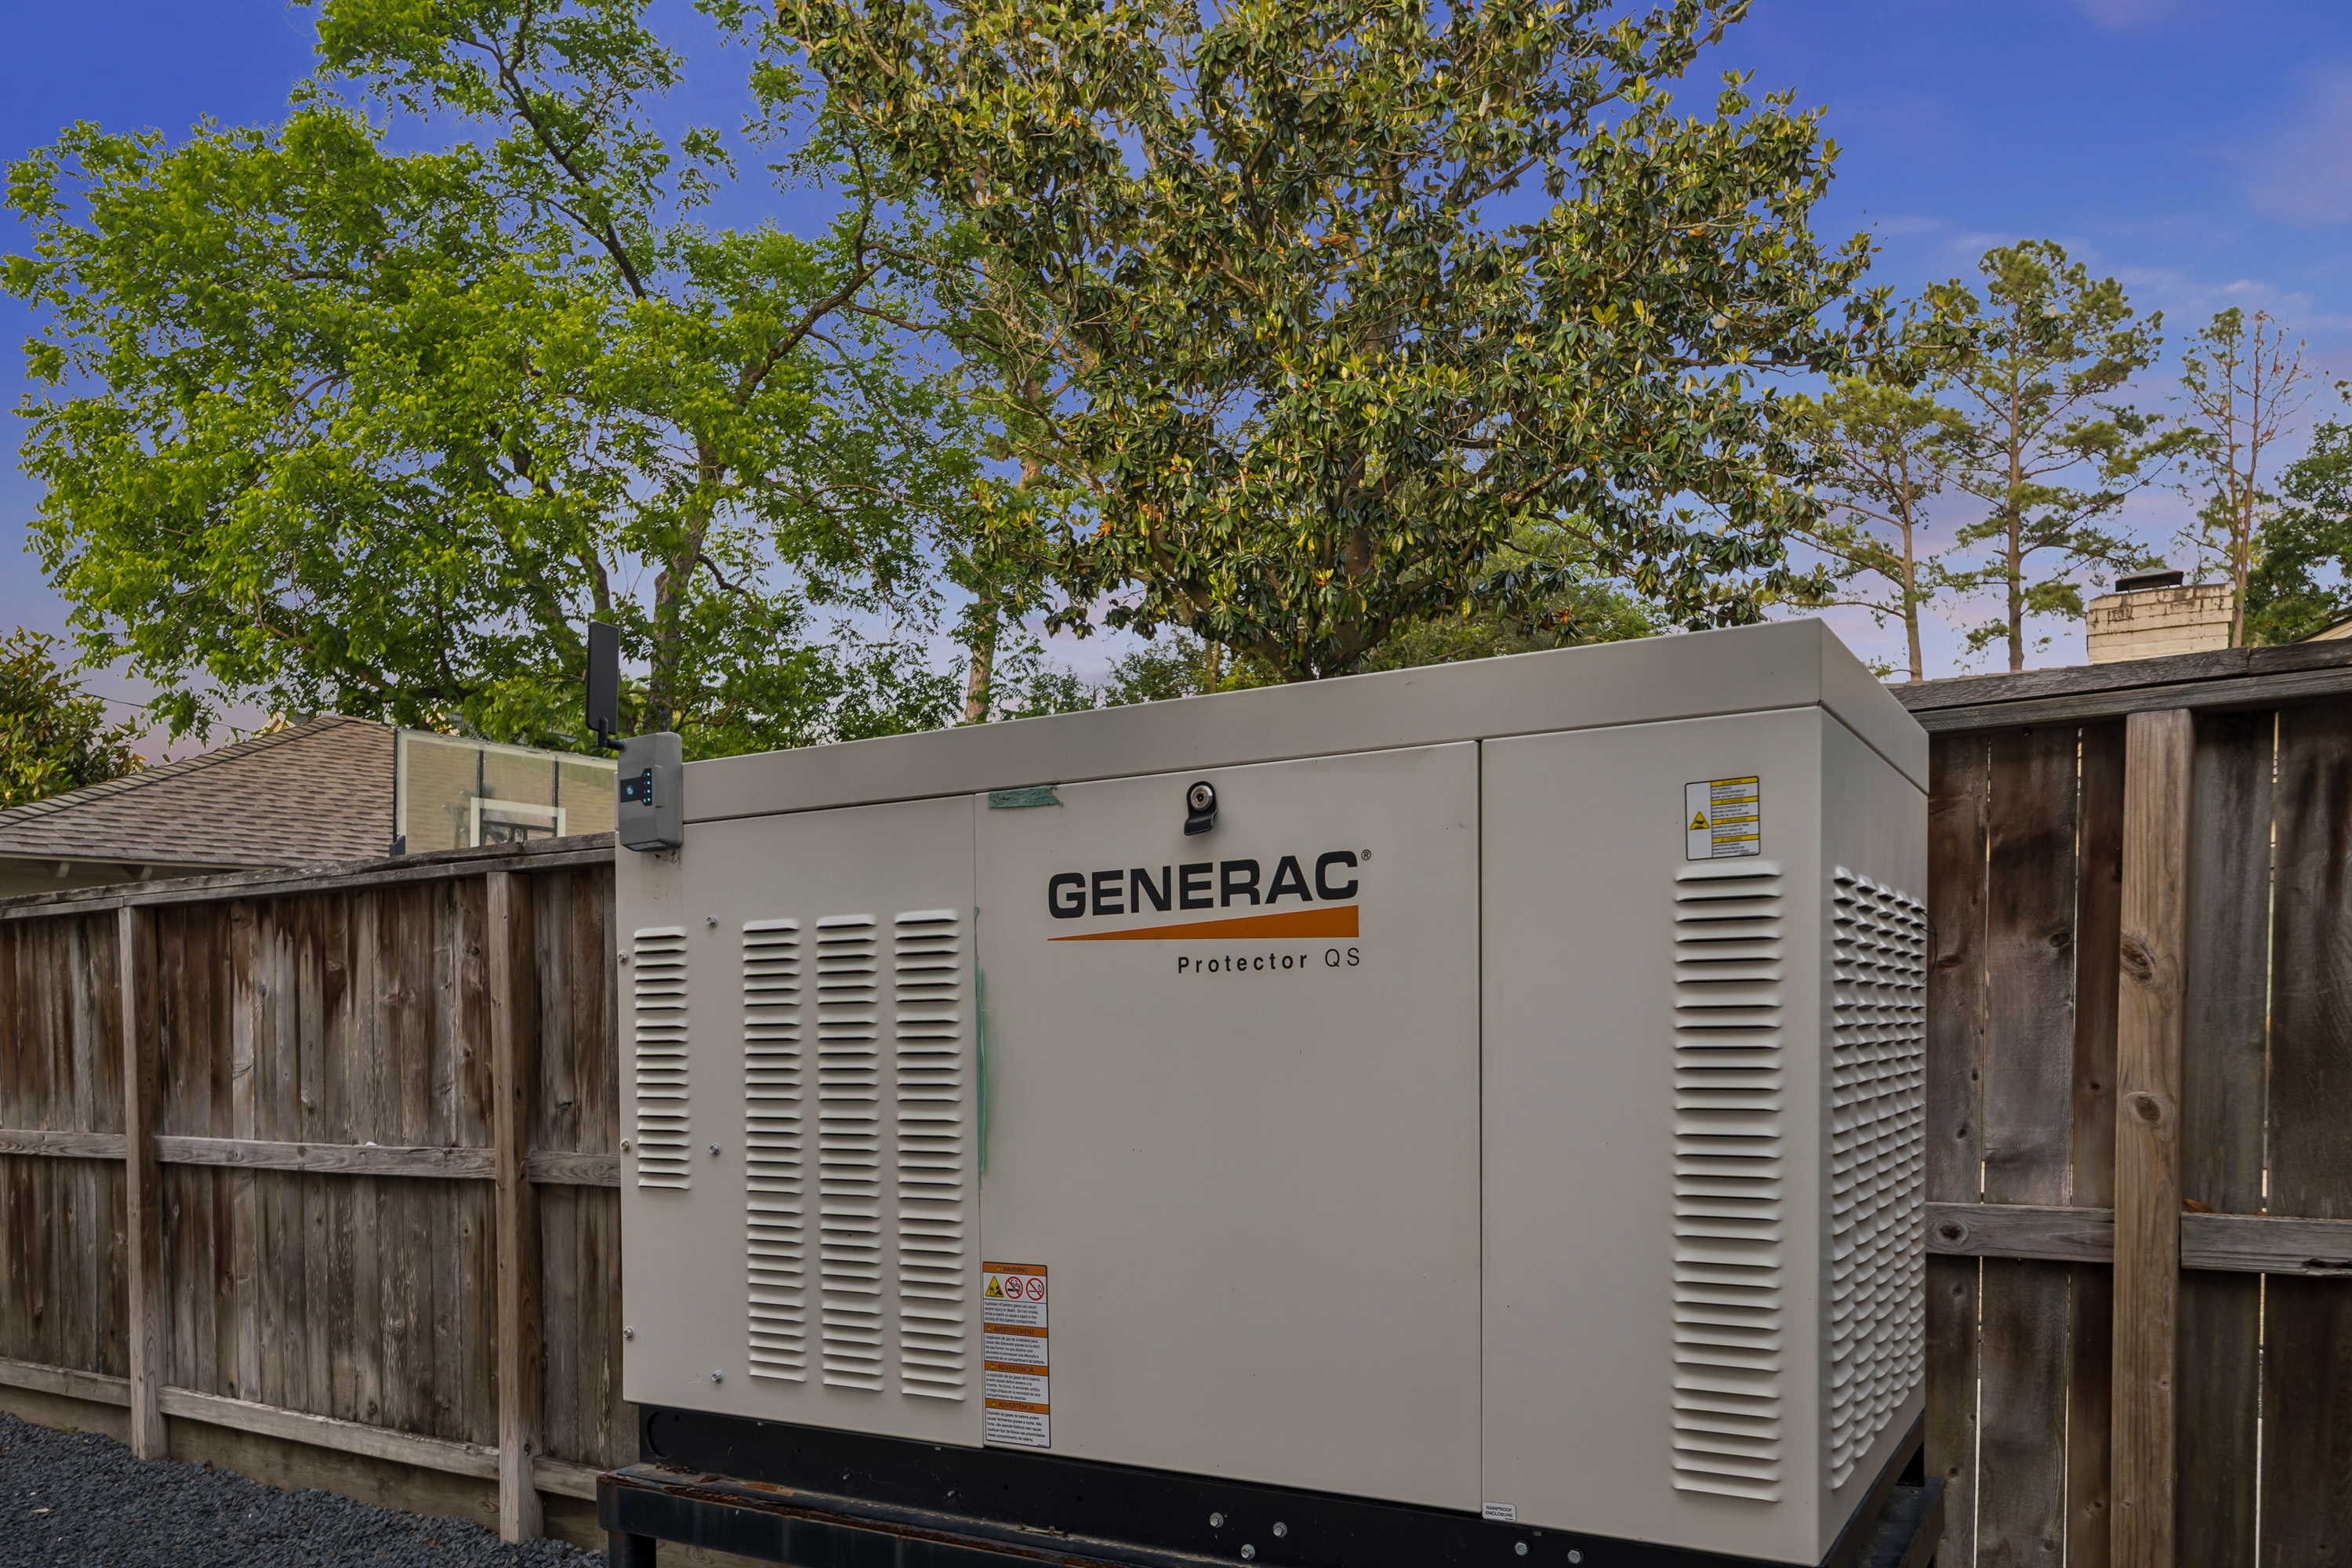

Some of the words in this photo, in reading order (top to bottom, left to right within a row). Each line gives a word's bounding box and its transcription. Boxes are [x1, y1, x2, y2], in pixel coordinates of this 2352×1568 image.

[1178, 953, 1307, 974] Protector
[1325, 947, 1359, 967] QS
[994, 1326, 1035, 1335] AVERTISSEMENT
[998, 1364, 1034, 1373] ADVERTENCIA
[999, 1401, 1035, 1410] ADVERTÊNCIA
